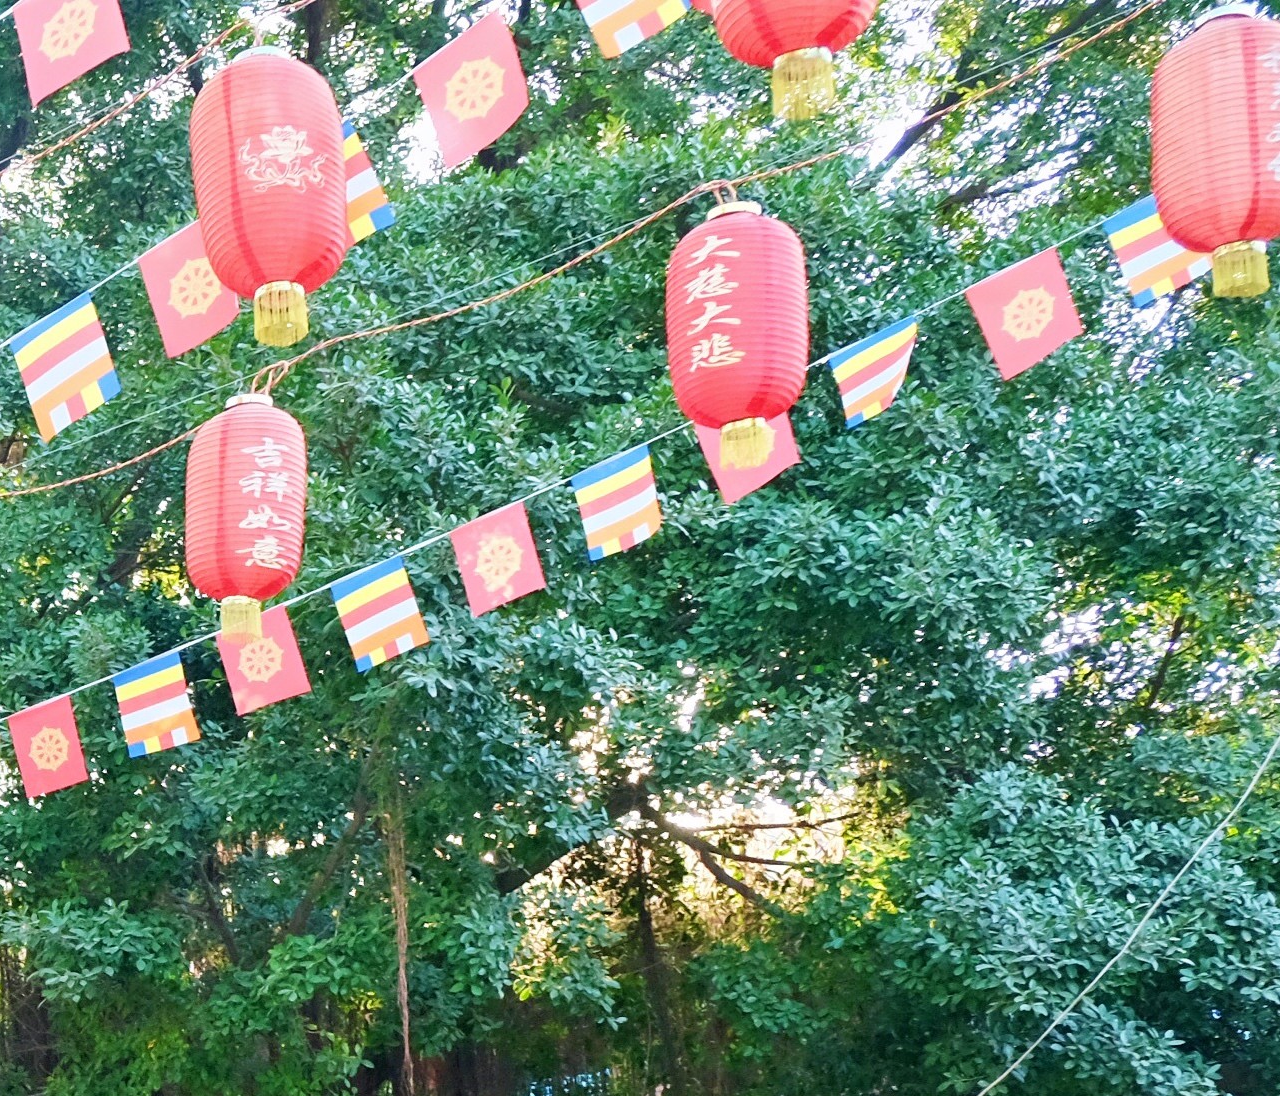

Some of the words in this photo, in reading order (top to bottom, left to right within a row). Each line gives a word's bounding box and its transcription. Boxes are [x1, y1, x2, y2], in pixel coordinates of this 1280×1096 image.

[683, 235, 746, 374] 大慈大悲
[235, 436, 293, 570] 吉祥如意
